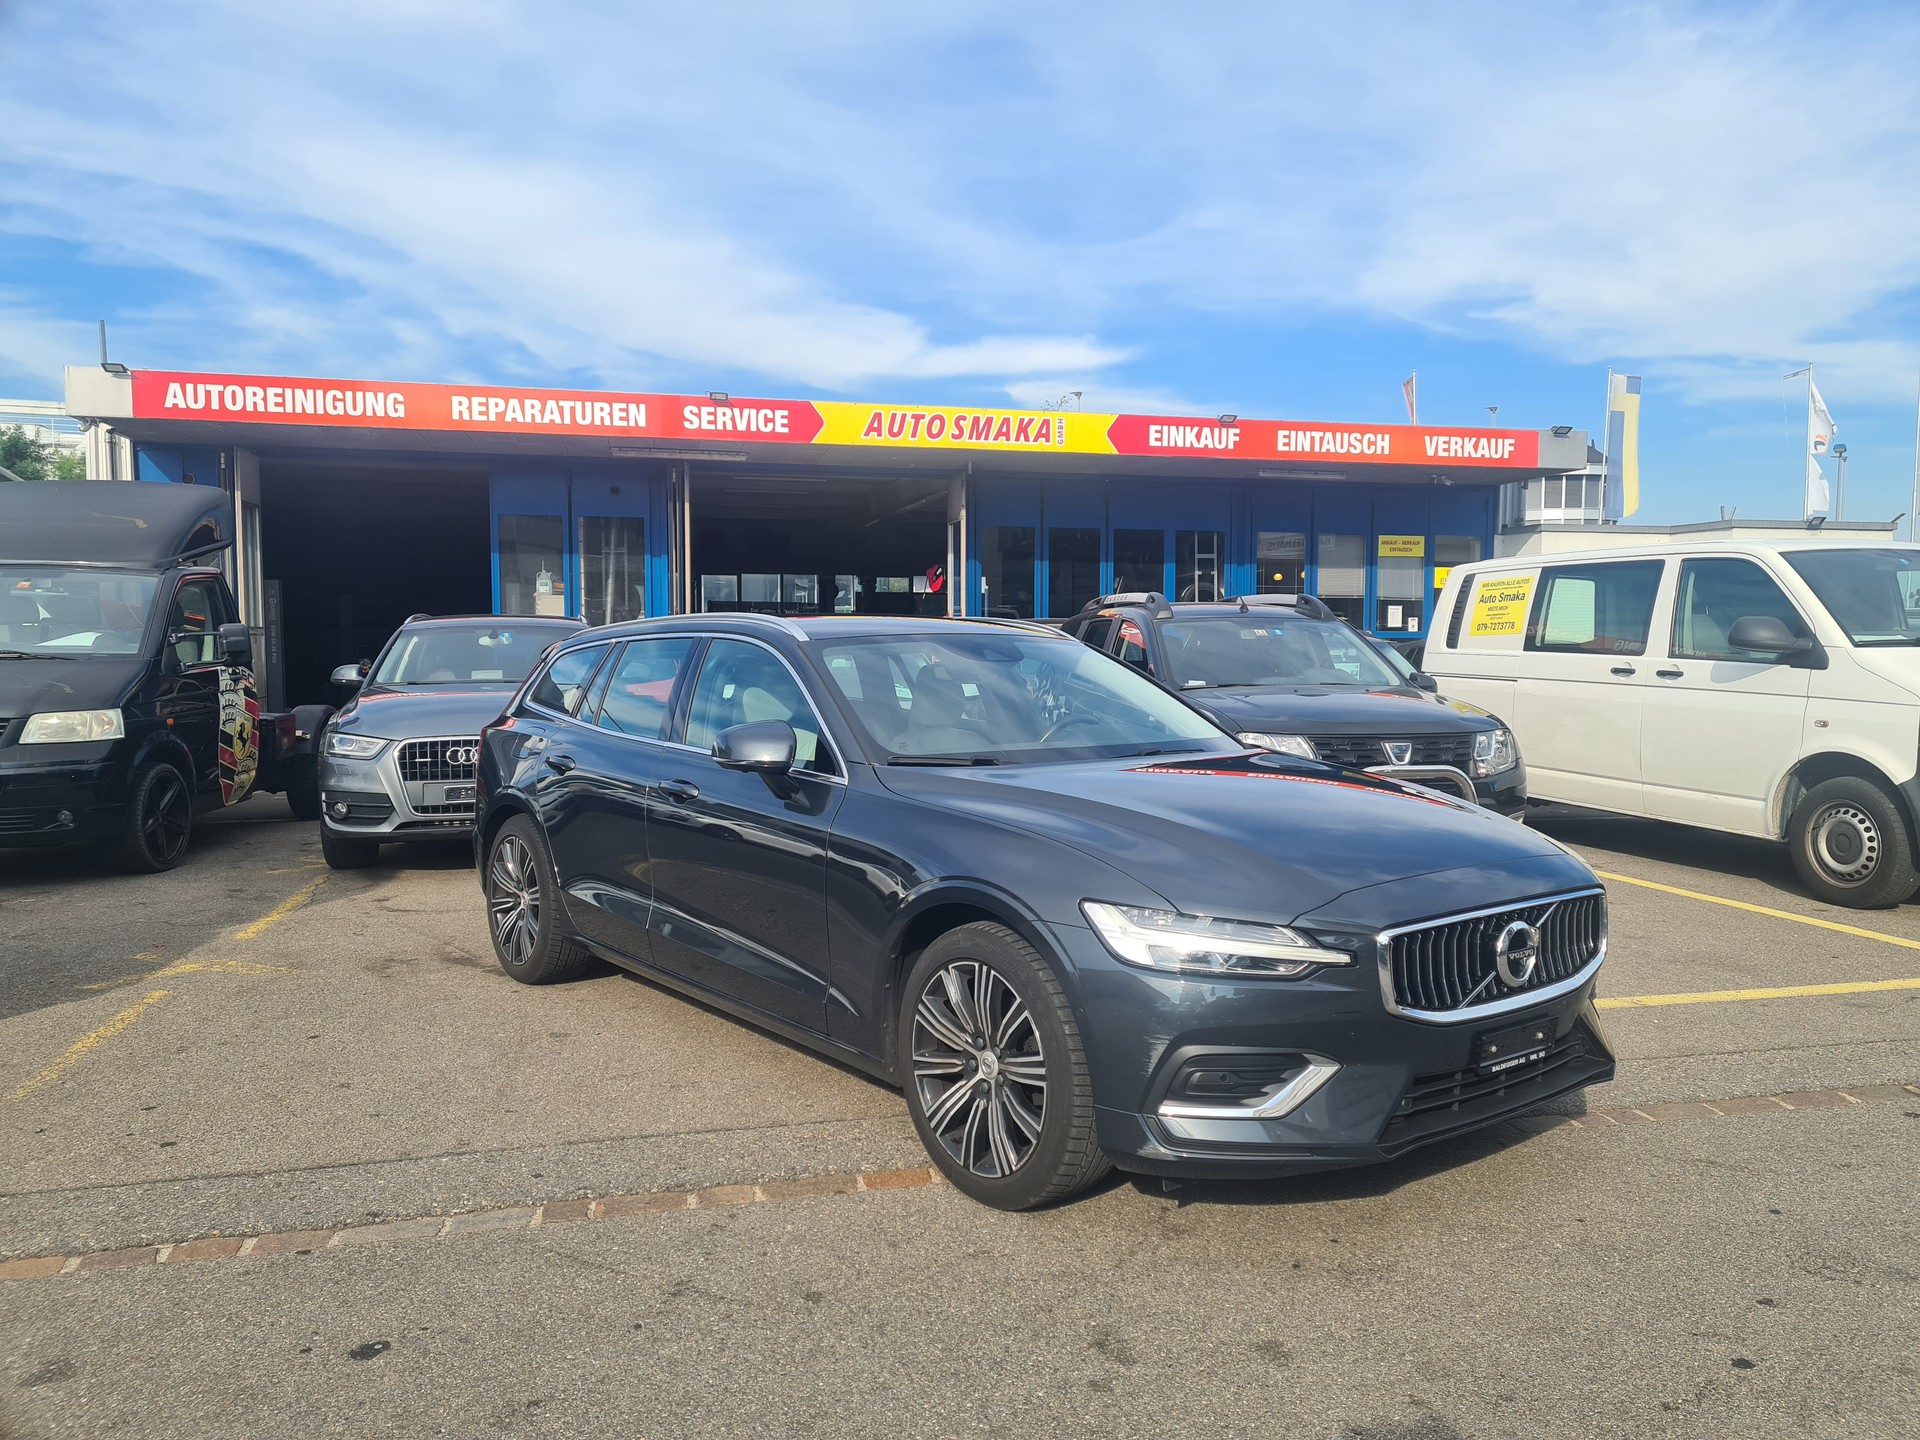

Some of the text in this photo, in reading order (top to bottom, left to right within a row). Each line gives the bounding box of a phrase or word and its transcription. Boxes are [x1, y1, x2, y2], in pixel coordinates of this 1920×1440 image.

[163, 382, 406, 418] AUTOREINIGUNG
[450, 395, 647, 428] REPARATUREN
[682, 404, 790, 434] SERVICE
[863, 411, 1051, 443] AUTO SMAKA
[1148, 424, 1241, 450] EINKAUF
[1276, 429, 1391, 455] EINTAUSCH
[1424, 435, 1516, 459] VERKAUF
[1479, 590, 1526, 604] Auto Smaka
[1508, 949, 1534, 960] VOLVO
[1492, 1059, 1518, 1072] BALDEGGER
[1519, 1056, 1526, 1064] AG
